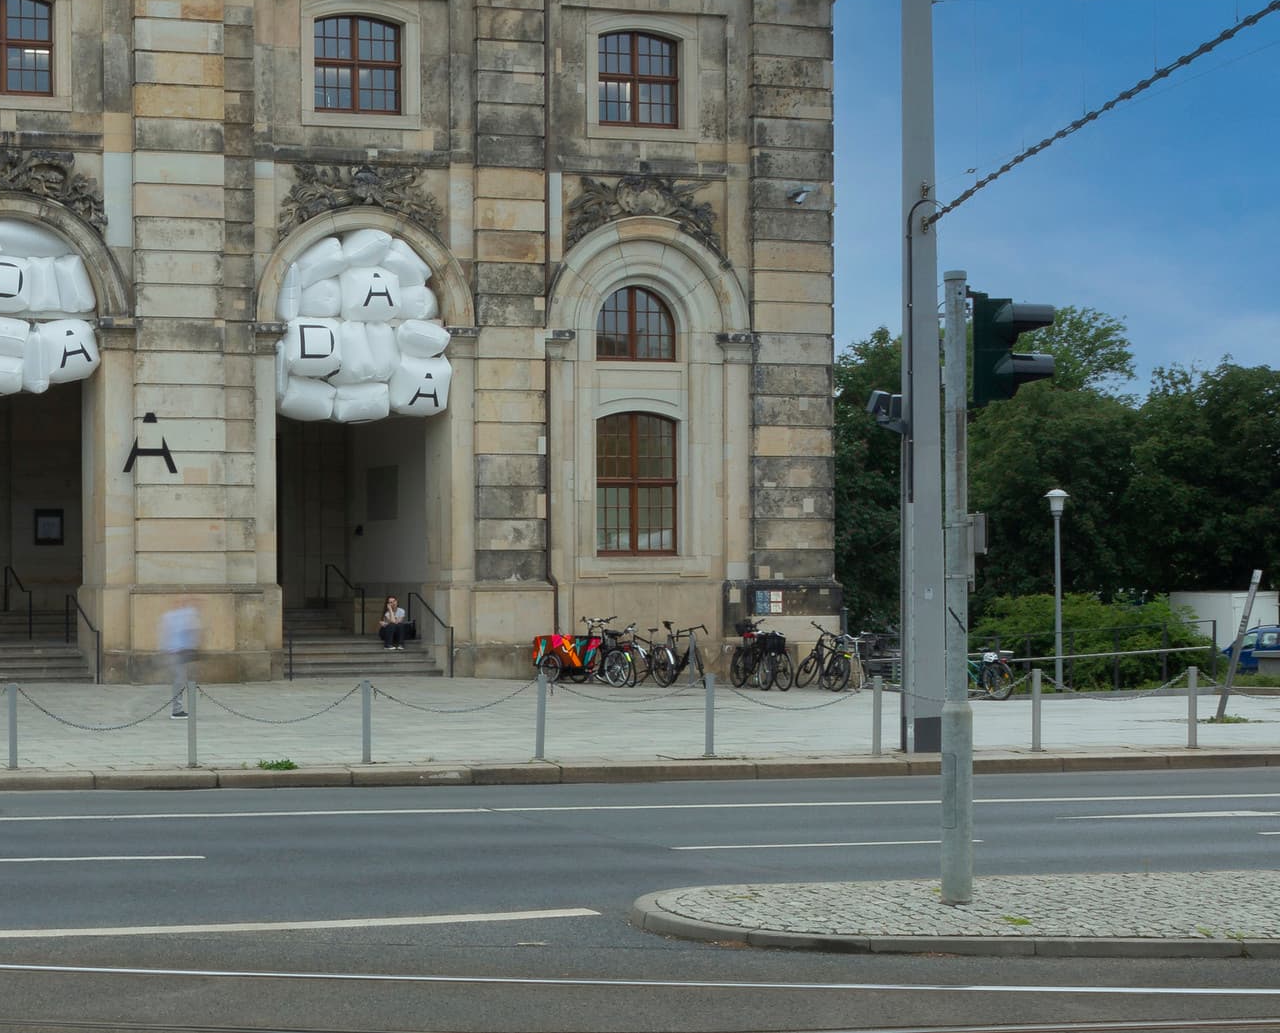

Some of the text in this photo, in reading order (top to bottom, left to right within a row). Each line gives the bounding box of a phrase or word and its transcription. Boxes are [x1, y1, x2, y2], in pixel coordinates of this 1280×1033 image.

[362, 272, 394, 307] A
[60, 329, 93, 368] A
[299, 324, 335, 359] D
[408, 372, 440, 408] A
[123, 412, 178, 474] A
